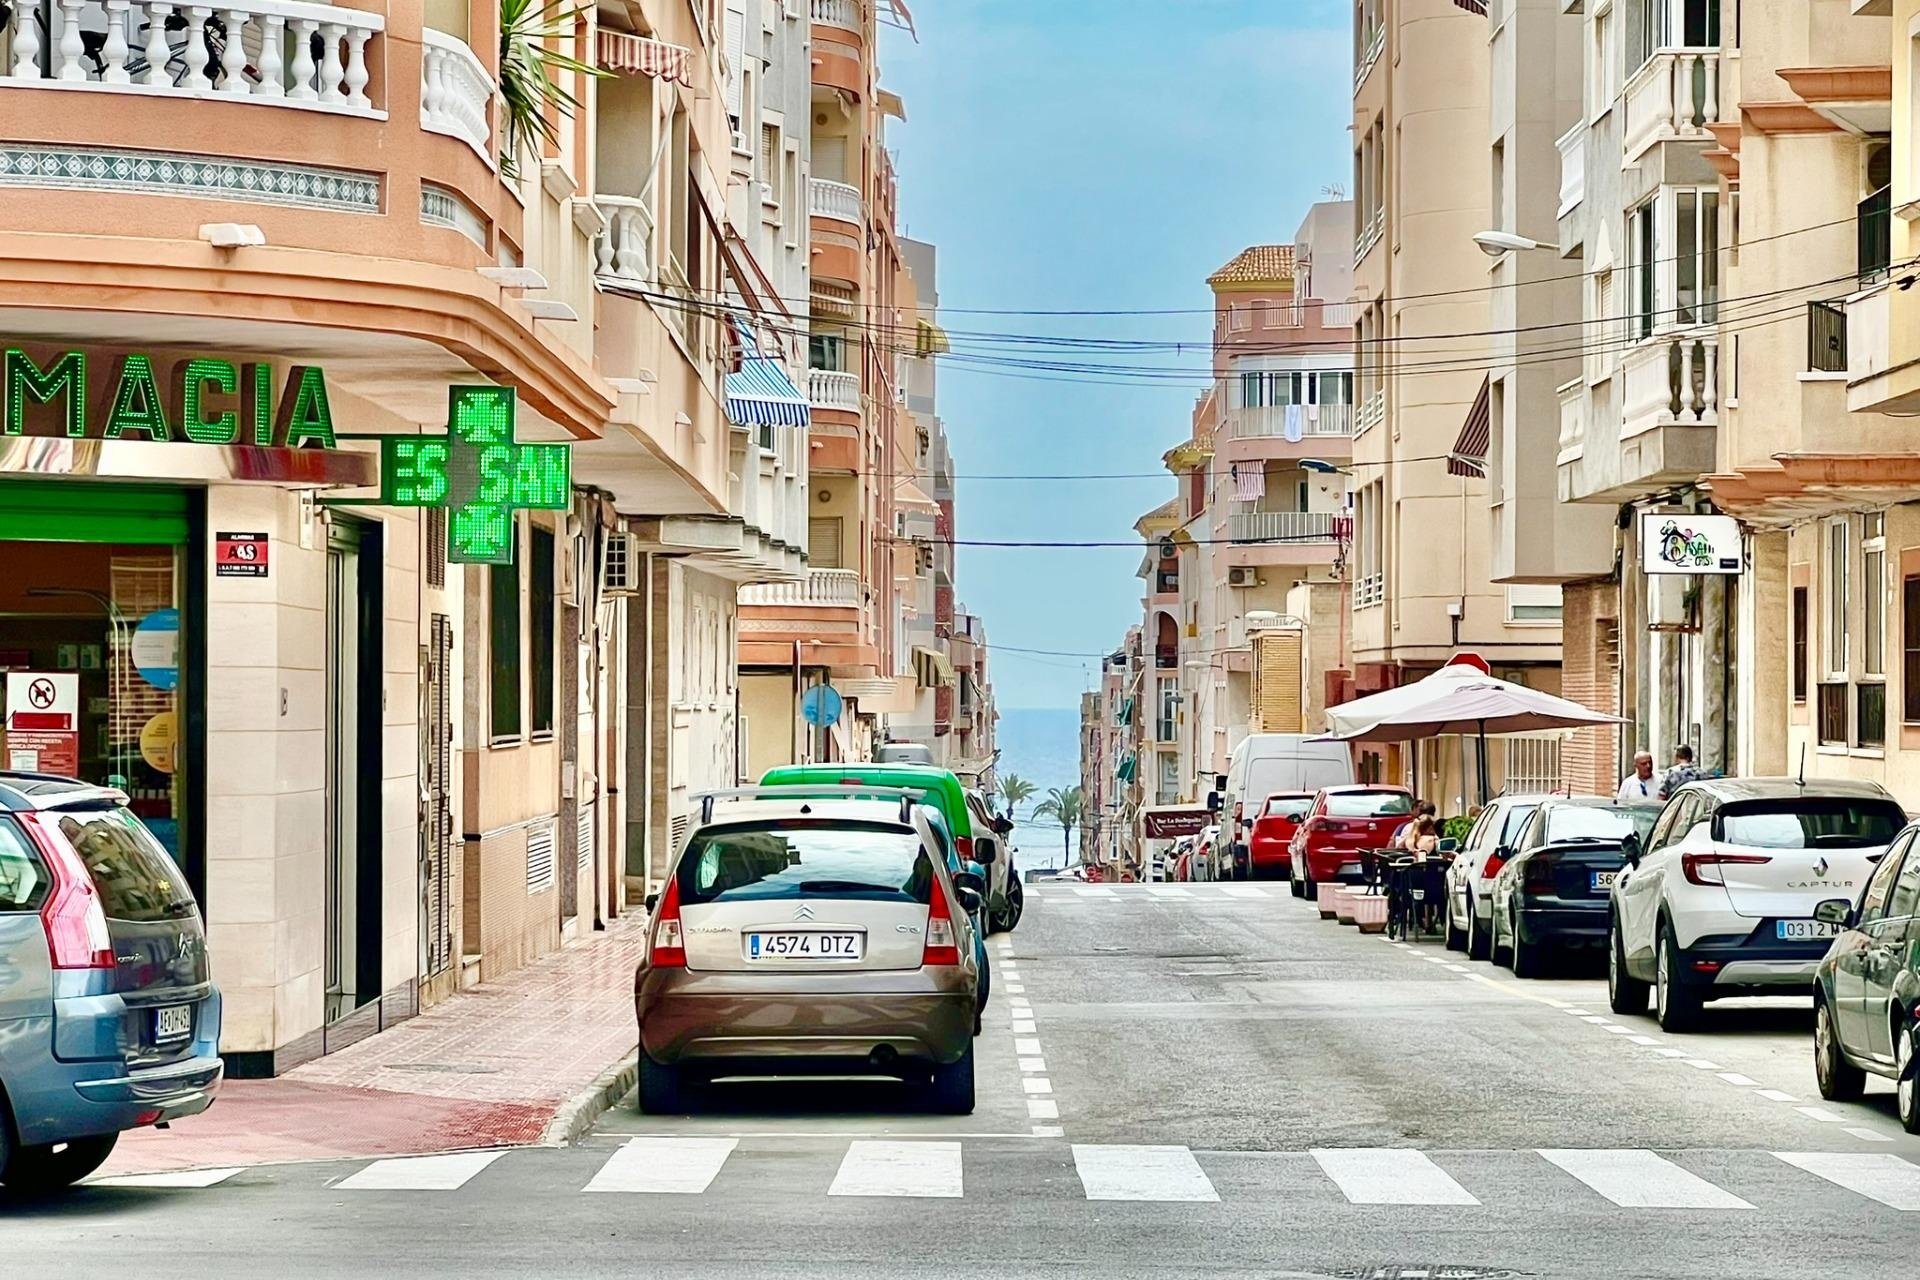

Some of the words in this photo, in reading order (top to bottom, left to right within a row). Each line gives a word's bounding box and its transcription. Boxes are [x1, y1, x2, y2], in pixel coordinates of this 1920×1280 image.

[4, 350, 337, 449] MACIA
[1787, 923, 1826, 936] 0312
[765, 935, 811, 954] 4574
[820, 935, 855, 954] DTZ
